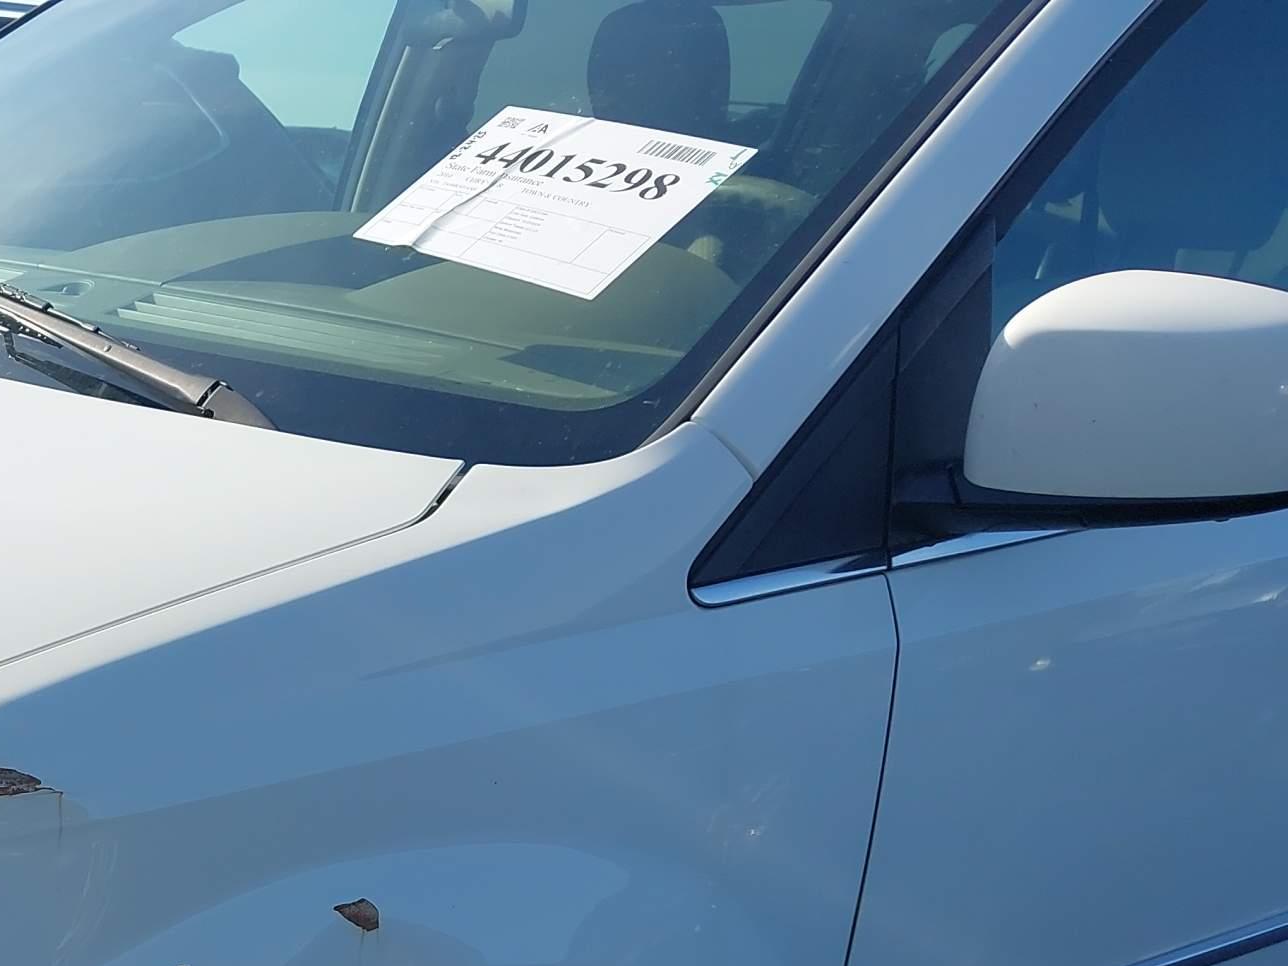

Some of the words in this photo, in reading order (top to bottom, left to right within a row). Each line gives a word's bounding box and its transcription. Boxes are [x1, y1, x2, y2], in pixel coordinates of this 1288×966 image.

[445, 161, 470, 172] State
[470, 165, 497, 177] Farm
[475, 142, 681, 200] 44015298
[552, 193, 591, 208] COUNTRY
